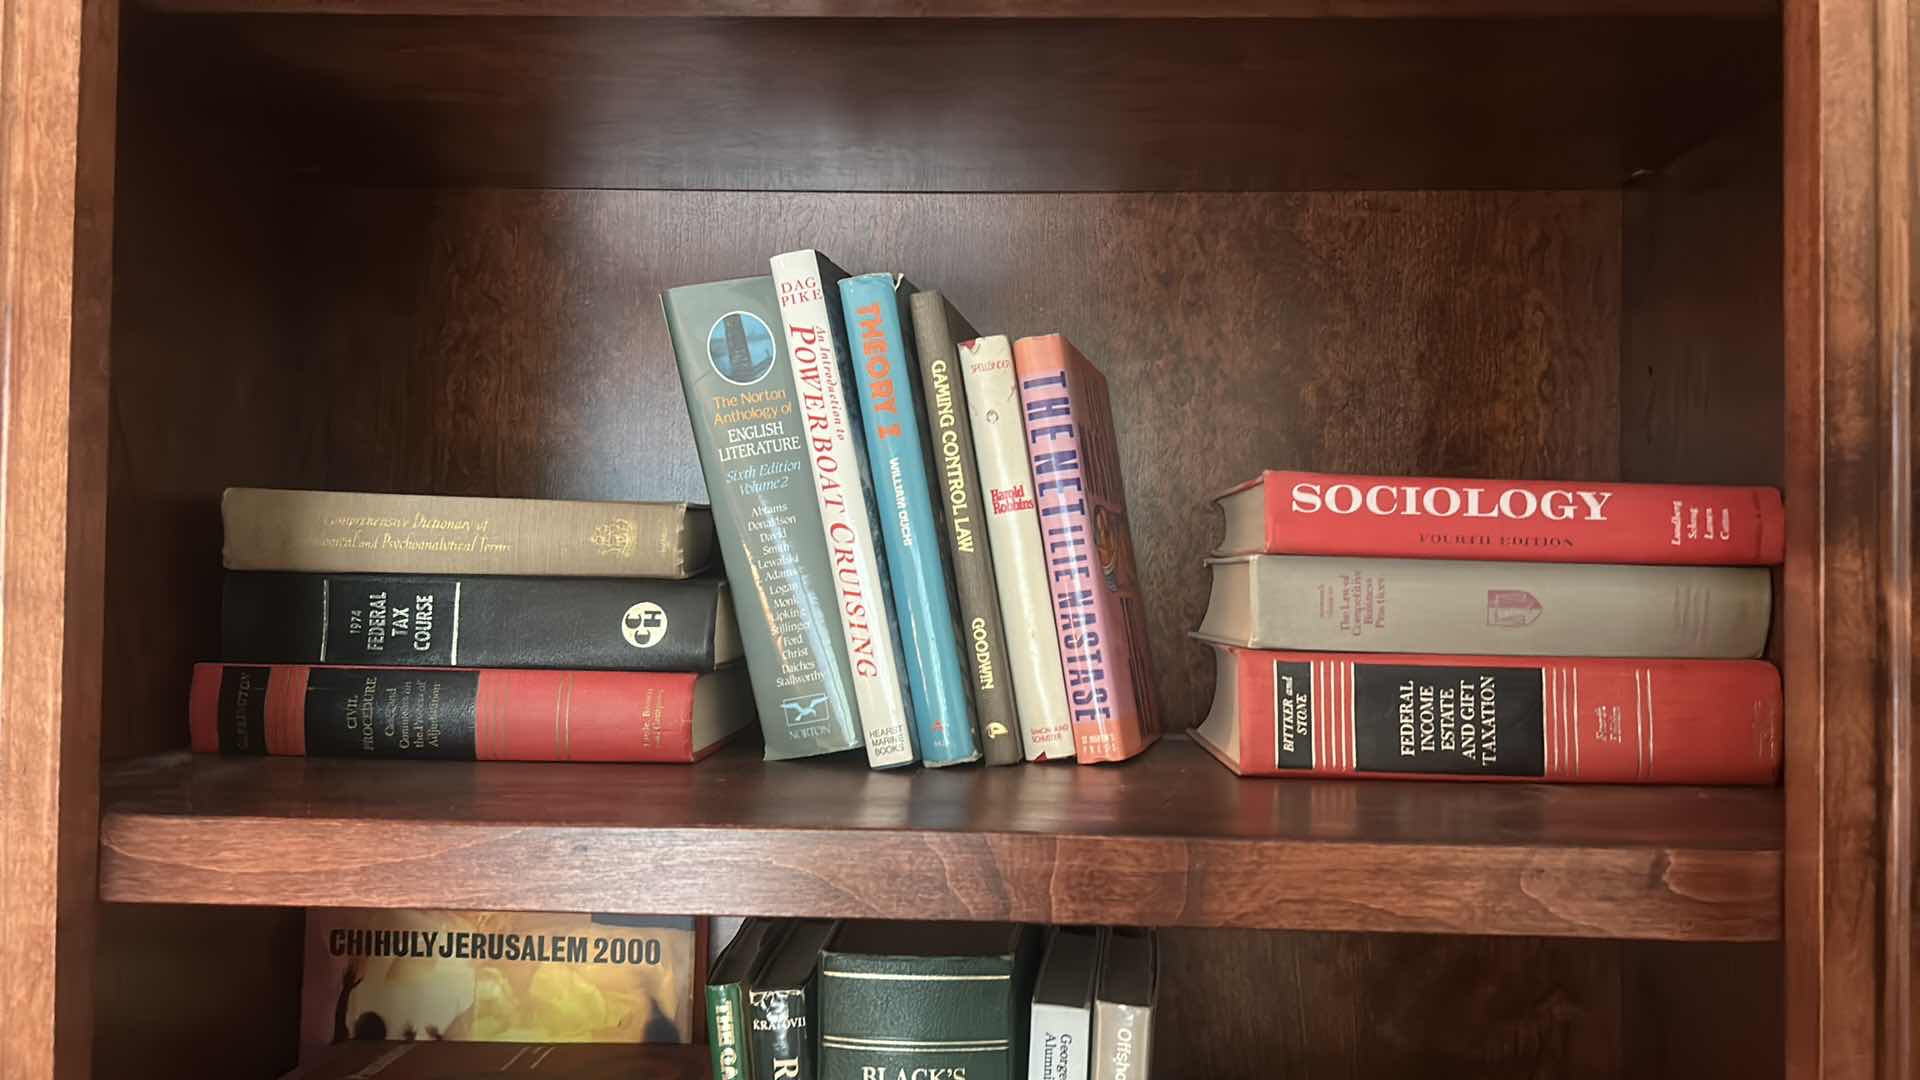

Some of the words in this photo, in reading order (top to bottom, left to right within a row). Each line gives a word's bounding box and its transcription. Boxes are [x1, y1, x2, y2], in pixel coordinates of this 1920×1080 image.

[780, 289, 824, 307] PIKE
[781, 276, 817, 294] DAG
[855, 302, 898, 414] THEORY
[713, 396, 738, 409] The
[741, 389, 786, 404] Norton
[820, 347, 841, 425] Introduction
[931, 359, 955, 428] GAMING
[714, 406, 779, 426] Anthology
[780, 402, 792, 416] of
[789, 324, 845, 515] POWERBOAT
[1023, 371, 1074, 444] THE
[719, 436, 801, 462] LITERATURE
[728, 421, 784, 443] ENGLISH
[726, 466, 757, 482] Sixth
[759, 460, 801, 477] Edition
[740, 480, 780, 496] Volume
[780, 476, 789, 489] 2
[889, 457, 907, 508] WILLIAM
[942, 430, 968, 516] CONTROL
[1034, 449, 1087, 516] NET
[991, 484, 1025, 502] Harold
[993, 497, 1034, 514] Robbins
[1291, 483, 1613, 521] SOCIOLOGY
[412, 511, 472, 532] Dictionary
[952, 518, 974, 553] LAW
[1419, 532, 1497, 545] FOURTH
[1500, 536, 1575, 547] EDITION
[830, 520, 878, 680] CRUISING
[349, 609, 362, 634] 1974
[367, 591, 388, 651] FEDERAL
[391, 607, 410, 637] TAX
[413, 595, 434, 651] COURSE
[971, 617, 995, 690] GOODWIN
[1057, 589, 1111, 722] NASTASE
[1282, 675, 1294, 696] and
[1460, 680, 1475, 721] GIFT
[347, 694, 359, 730] CIVIL
[361, 676, 378, 752] PROCEDURE
[1283, 699, 1295, 752] BITTKER
[1296, 694, 1308, 735] STONE
[1400, 680, 1415, 757] FEDERAL
[1420, 685, 1435, 752] INCOME
[1440, 688, 1455, 751] ESTATE
[1480, 675, 1497, 766] TAXATION
[875, 743, 905, 756] BOOKS
[1461, 724, 1476, 760] AND
[330, 929, 438, 958] CHIHULY
[438, 931, 588, 964] JERUSALEM
[593, 937, 662, 966] 2000
[715, 1000, 736, 1047] THE
